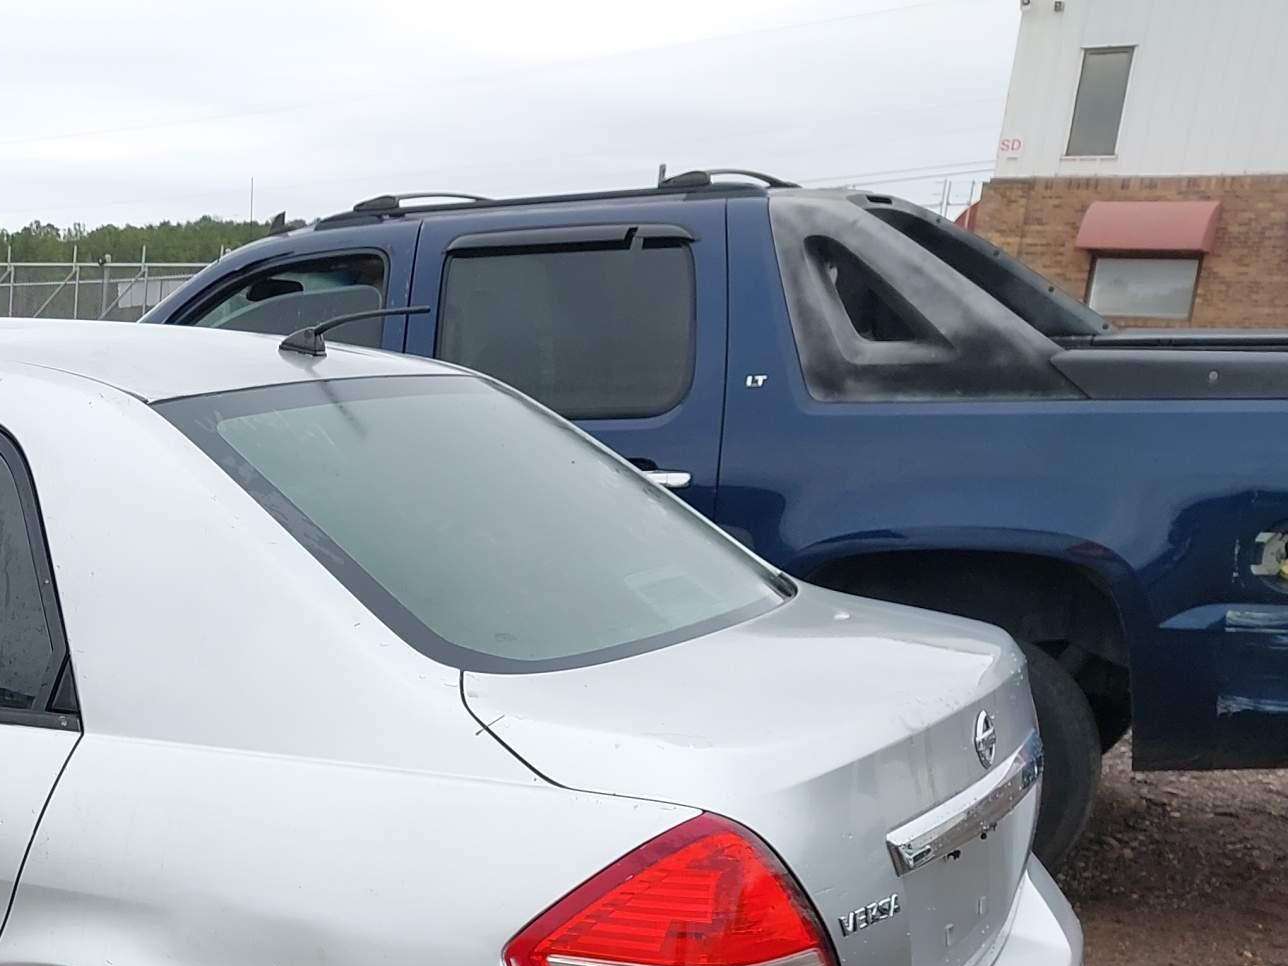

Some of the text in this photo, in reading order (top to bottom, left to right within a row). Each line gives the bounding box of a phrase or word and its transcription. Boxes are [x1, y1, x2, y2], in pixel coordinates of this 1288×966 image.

[1000, 138, 1022, 151] SD
[746, 375, 768, 387] LT
[838, 893, 900, 937] VERSA
